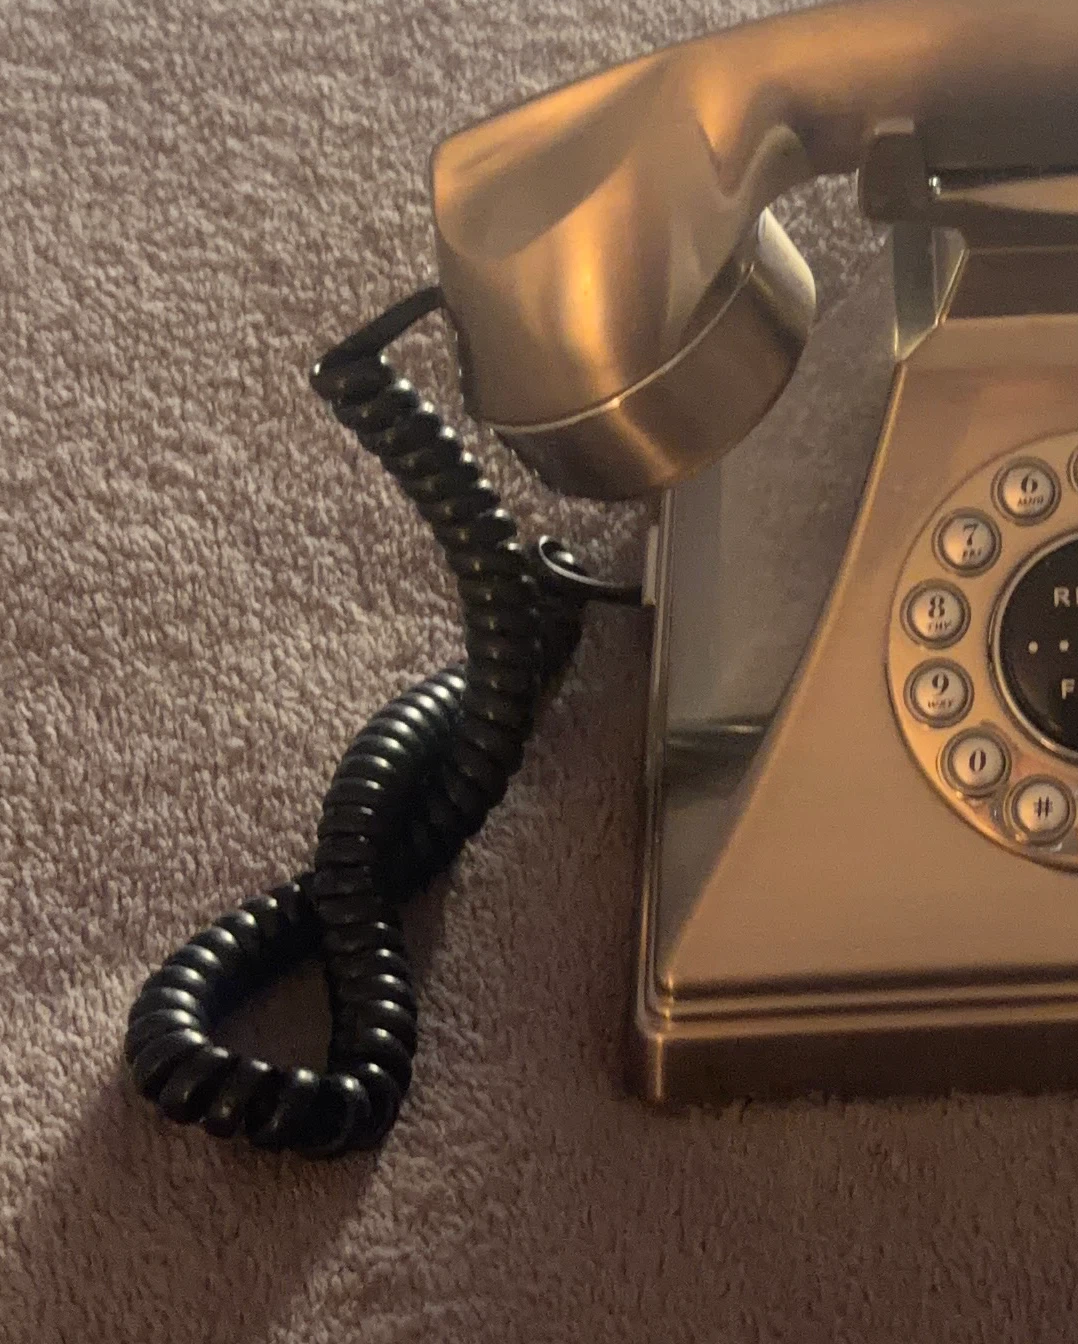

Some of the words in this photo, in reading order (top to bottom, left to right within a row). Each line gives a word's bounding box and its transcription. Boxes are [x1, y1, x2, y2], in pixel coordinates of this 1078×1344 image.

[1020, 469, 1039, 494] 6
[963, 523, 979, 546] 7
[928, 597, 945, 619] 8
[932, 674, 949, 696] 9
[969, 748, 986, 772] 0
